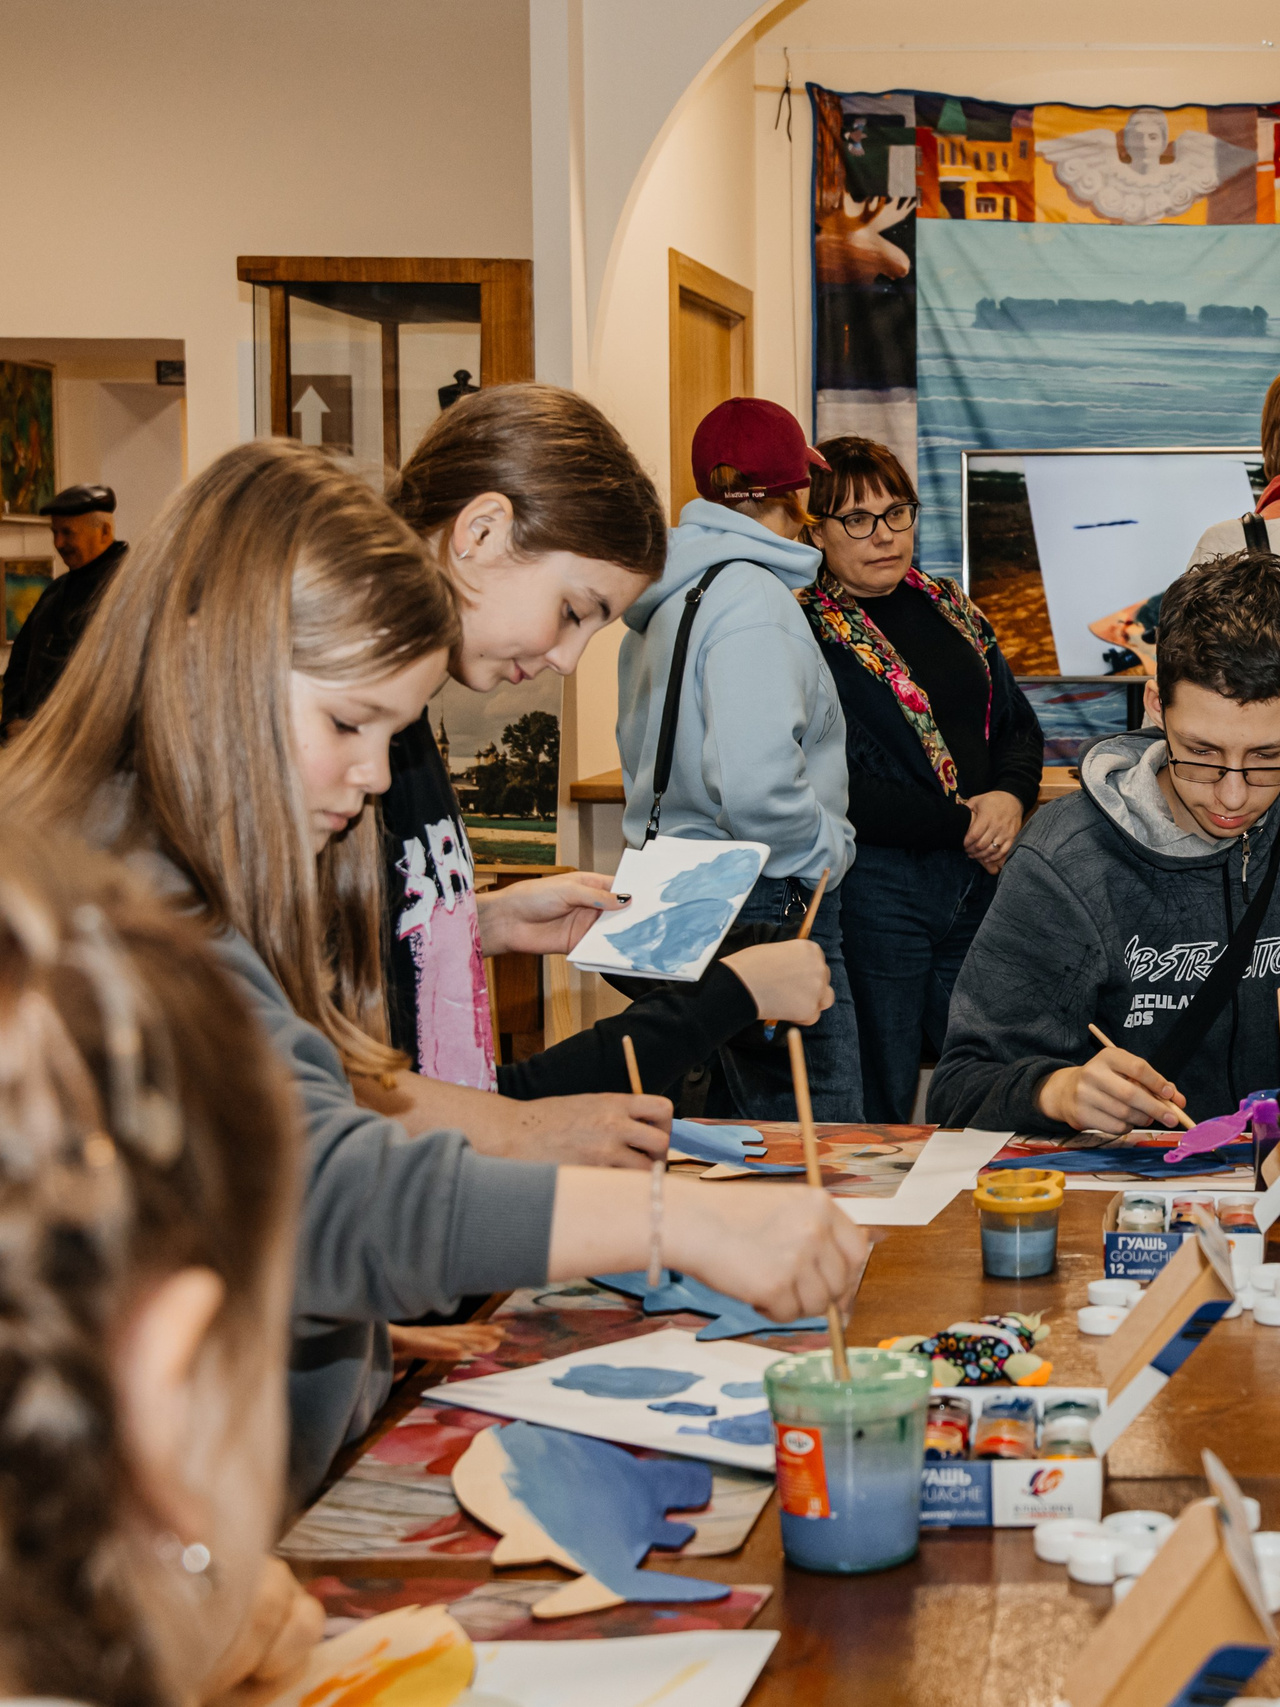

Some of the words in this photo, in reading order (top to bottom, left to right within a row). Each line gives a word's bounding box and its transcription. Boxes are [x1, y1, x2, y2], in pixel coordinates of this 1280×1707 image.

[1130, 994, 1196, 1011] ECULA
[1118, 1236, 1168, 1251] ГУАШЬ
[1110, 1263, 1125, 1275] 12
[920, 1467, 972, 1487] УАШЬ
[923, 1486, 983, 1503] UACHE
